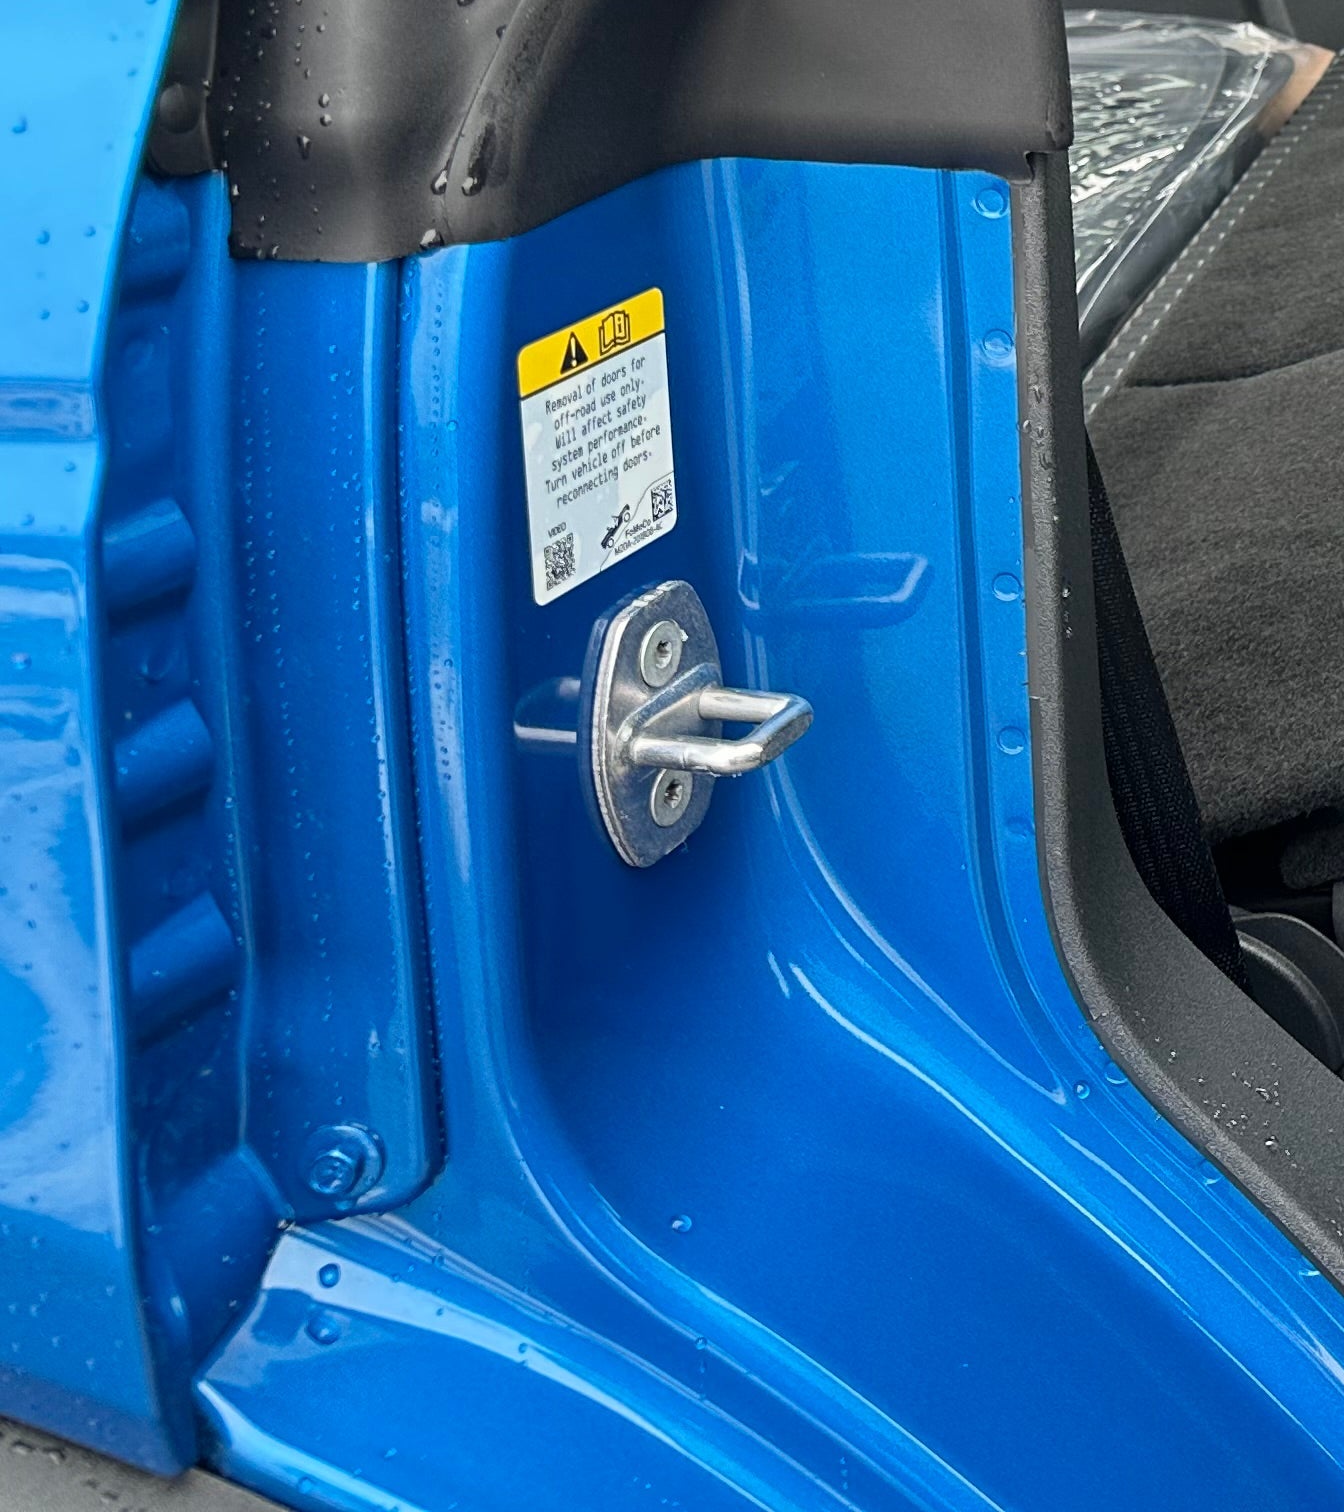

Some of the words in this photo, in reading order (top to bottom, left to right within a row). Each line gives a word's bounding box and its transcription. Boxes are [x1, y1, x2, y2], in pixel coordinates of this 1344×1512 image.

[545, 384, 583, 416] Removal
[585, 377, 597, 396] of
[601, 366, 627, 388] doors
[631, 356, 646, 372] for
[554, 397, 597, 431] off-road
[600, 390, 616, 408] use
[620, 378, 645, 397] only.
[551, 445, 584, 473] system
[587, 414, 648, 457] performance.
[555, 427, 577, 450] Will
[581, 409, 613, 437] affect
[616, 394, 647, 419] safety
[545, 474, 568, 494] Turn
[571, 452, 608, 481] vehicle
[611, 439, 626, 460] off
[630, 424, 661, 449] before
[556, 466, 619, 509] reconnecting
[623, 450, 652, 472] doors.
